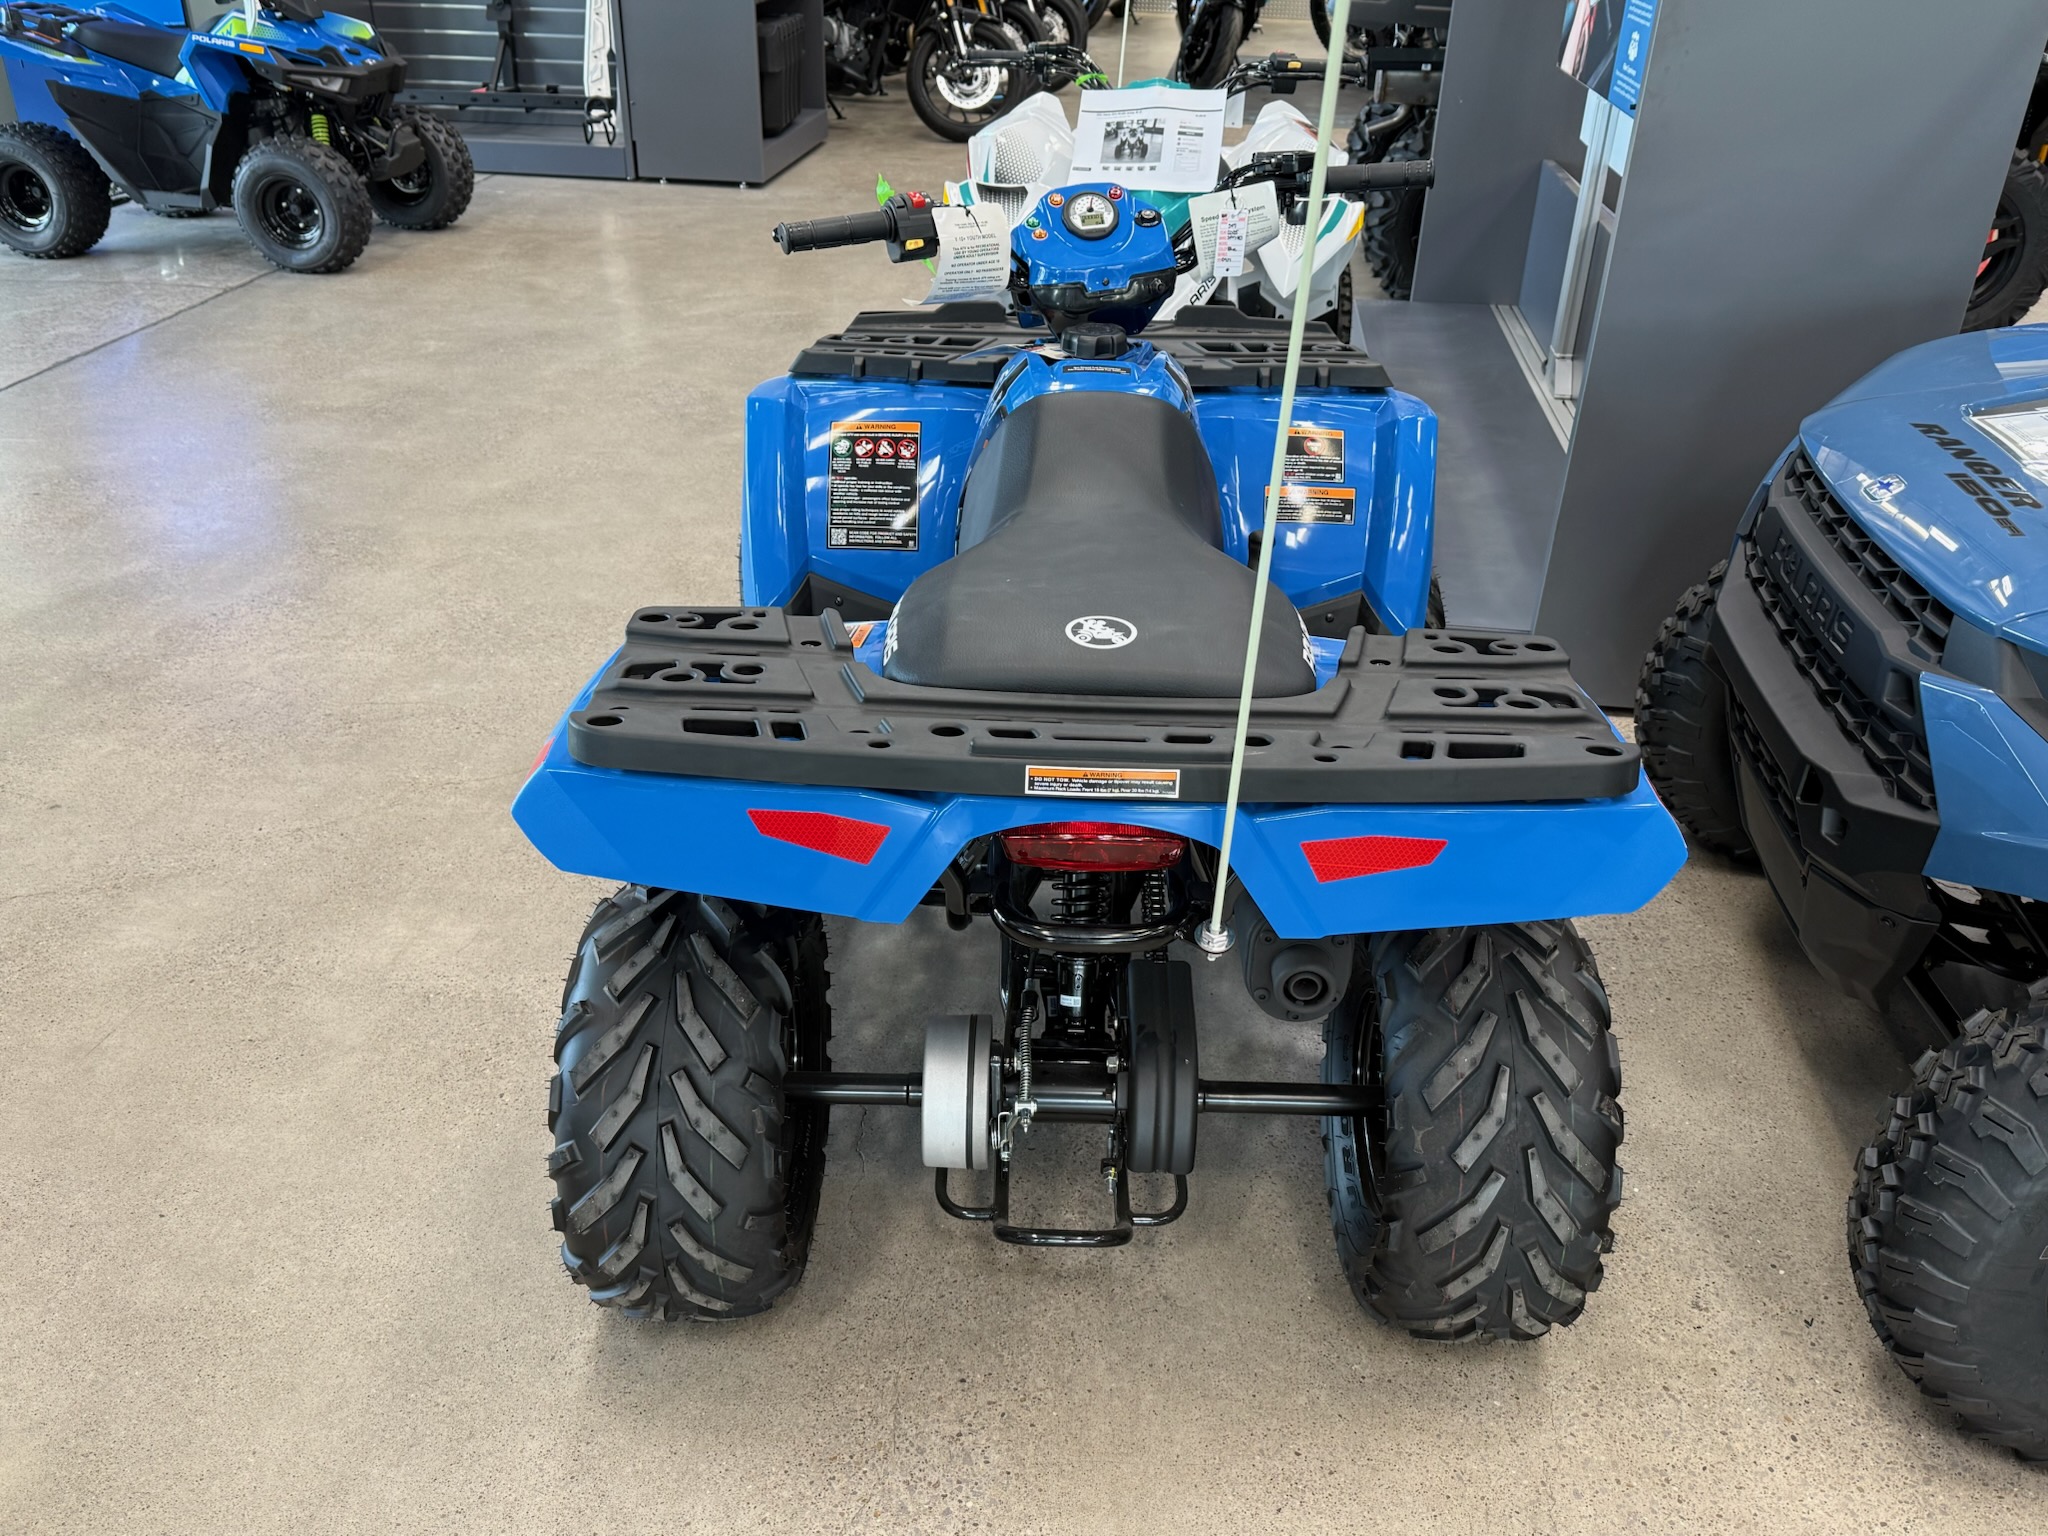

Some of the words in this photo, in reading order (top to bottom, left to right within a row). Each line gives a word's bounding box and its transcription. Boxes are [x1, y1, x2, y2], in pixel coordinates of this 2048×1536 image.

[192, 34, 235, 48] POLARIS
[1908, 422, 2044, 509] RANGER
[1771, 527, 1854, 655] POLARIS
